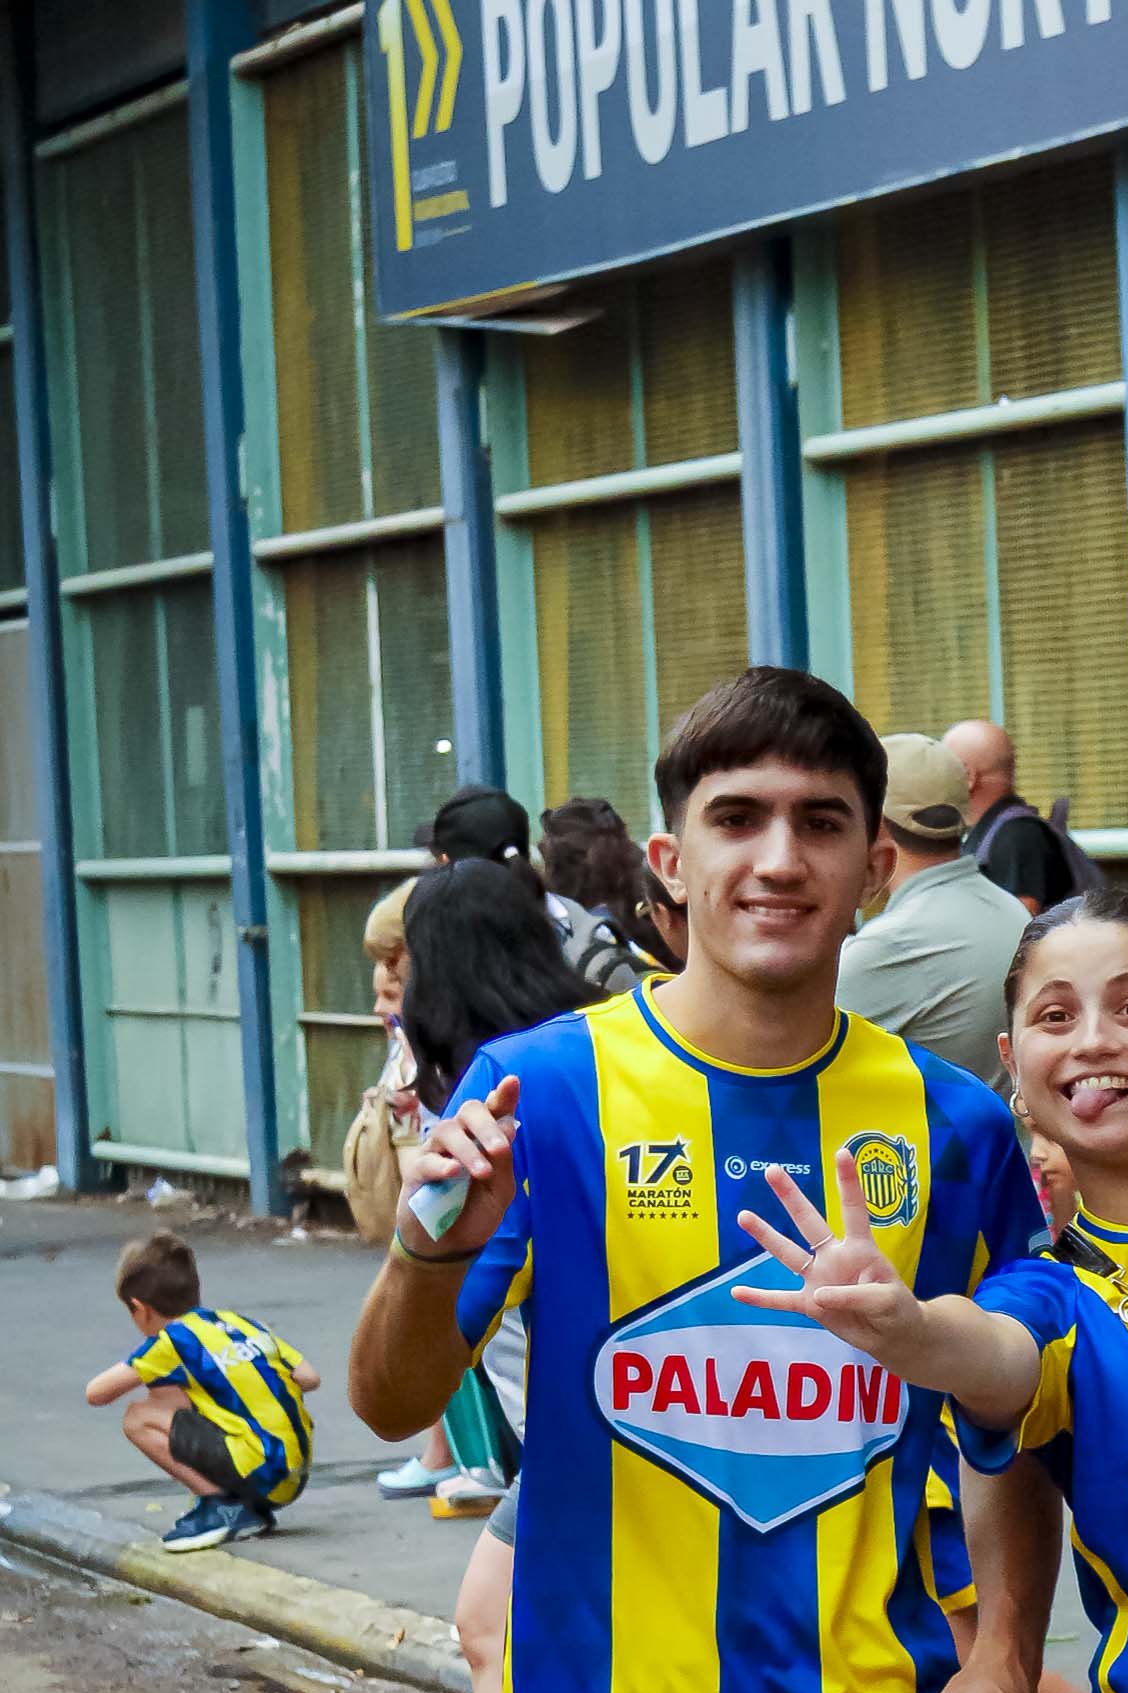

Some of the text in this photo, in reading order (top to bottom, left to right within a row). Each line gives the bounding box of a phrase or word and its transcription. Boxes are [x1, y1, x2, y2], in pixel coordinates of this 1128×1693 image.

[619, 1139, 688, 1184] 17
[750, 1159, 811, 1175] exress
[627, 1186, 692, 1199] MARATÓN
[628, 1199, 692, 1208] CANALLA
[611, 1351, 902, 1425] PALADINI
